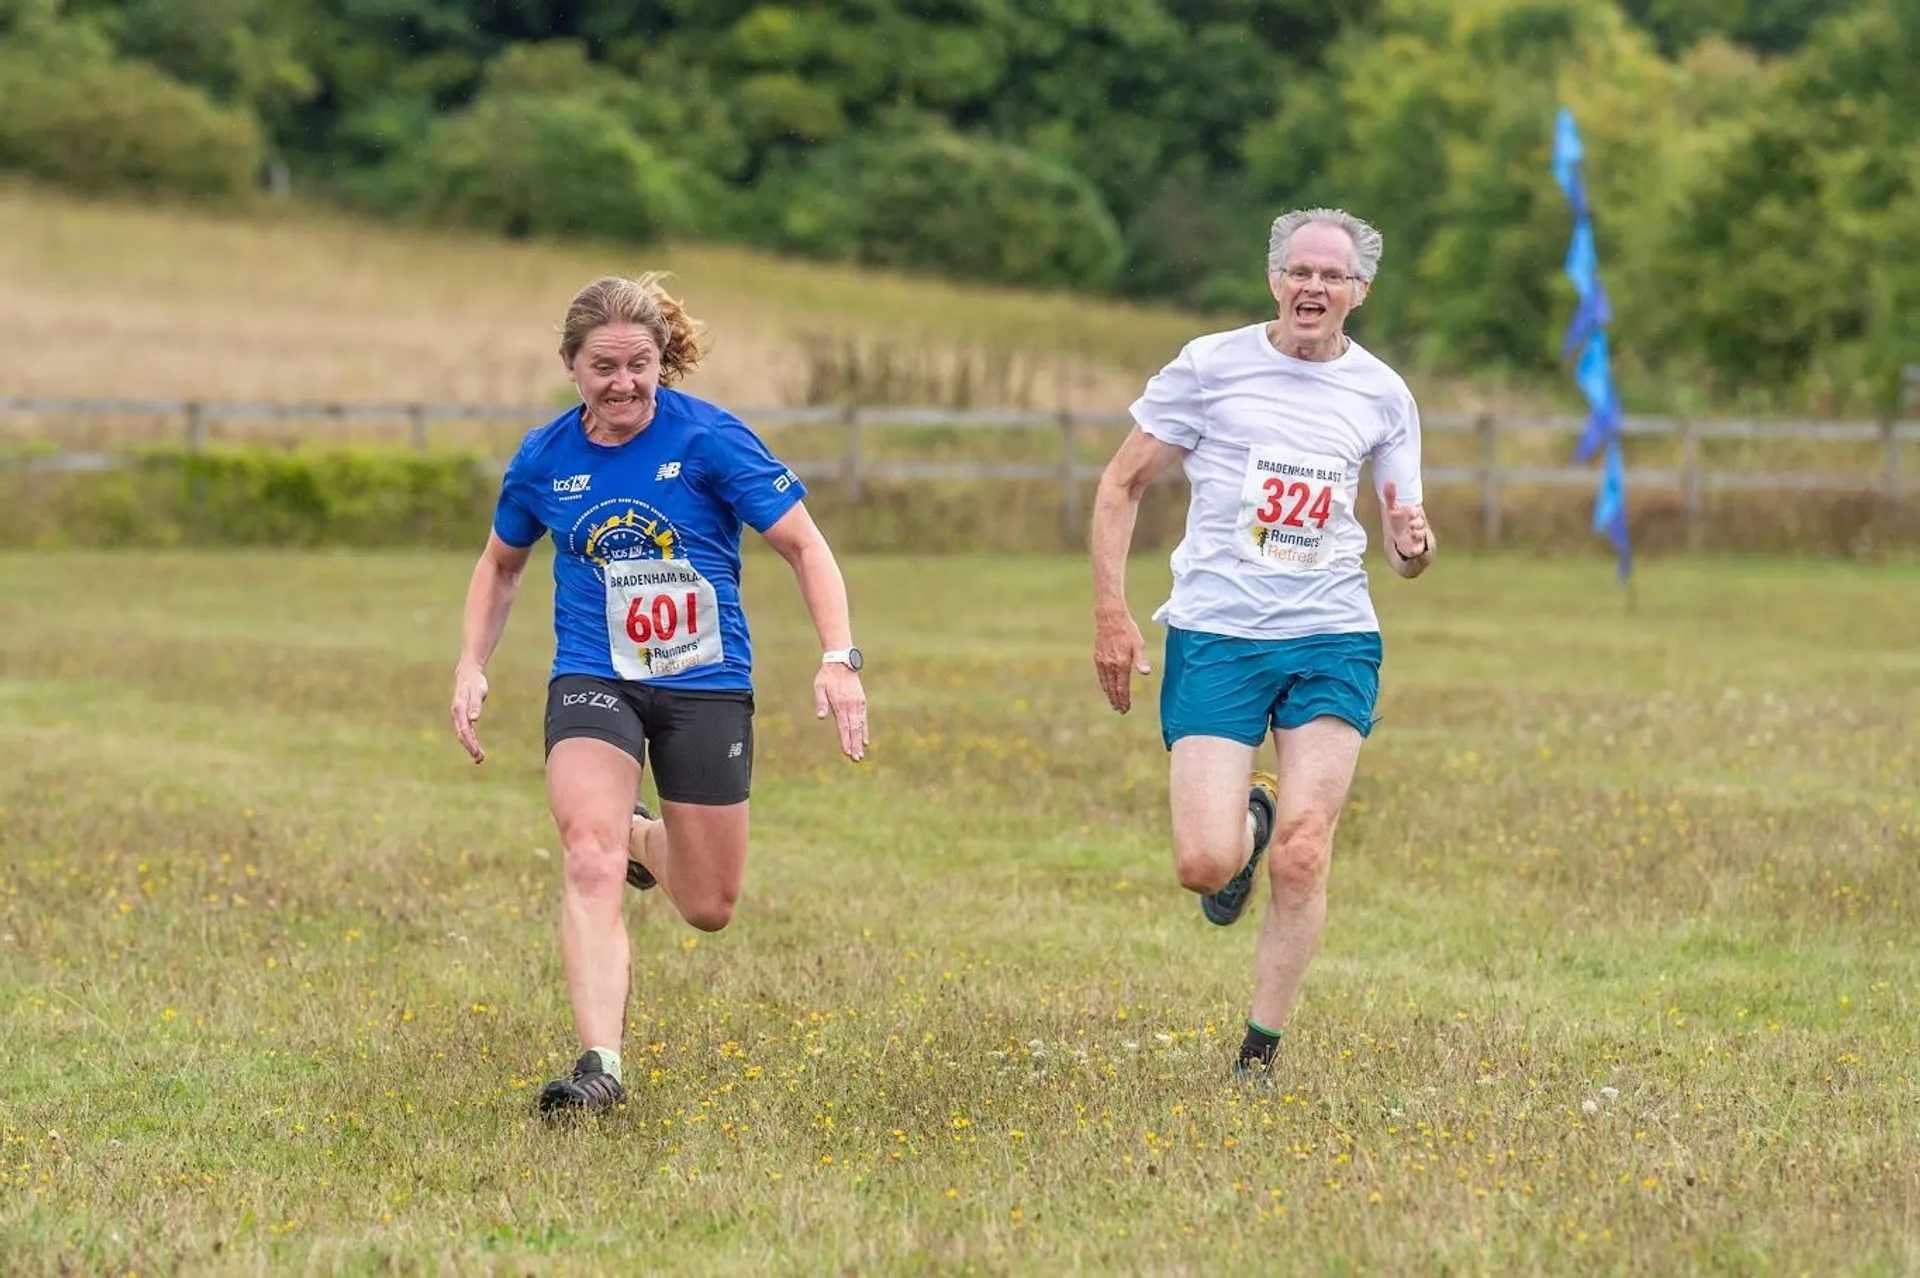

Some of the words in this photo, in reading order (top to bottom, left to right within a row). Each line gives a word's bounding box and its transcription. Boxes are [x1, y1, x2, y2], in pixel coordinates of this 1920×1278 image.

[1257, 460, 1314, 478] BRADENHAM
[1316, 469, 1342, 483] BLAST
[1256, 477, 1332, 529] 324
[1268, 544, 1318, 564] Retreat
[610, 572, 677, 588] BRADENHAM
[626, 592, 698, 643] 601
[655, 654, 701, 673] Retreat
